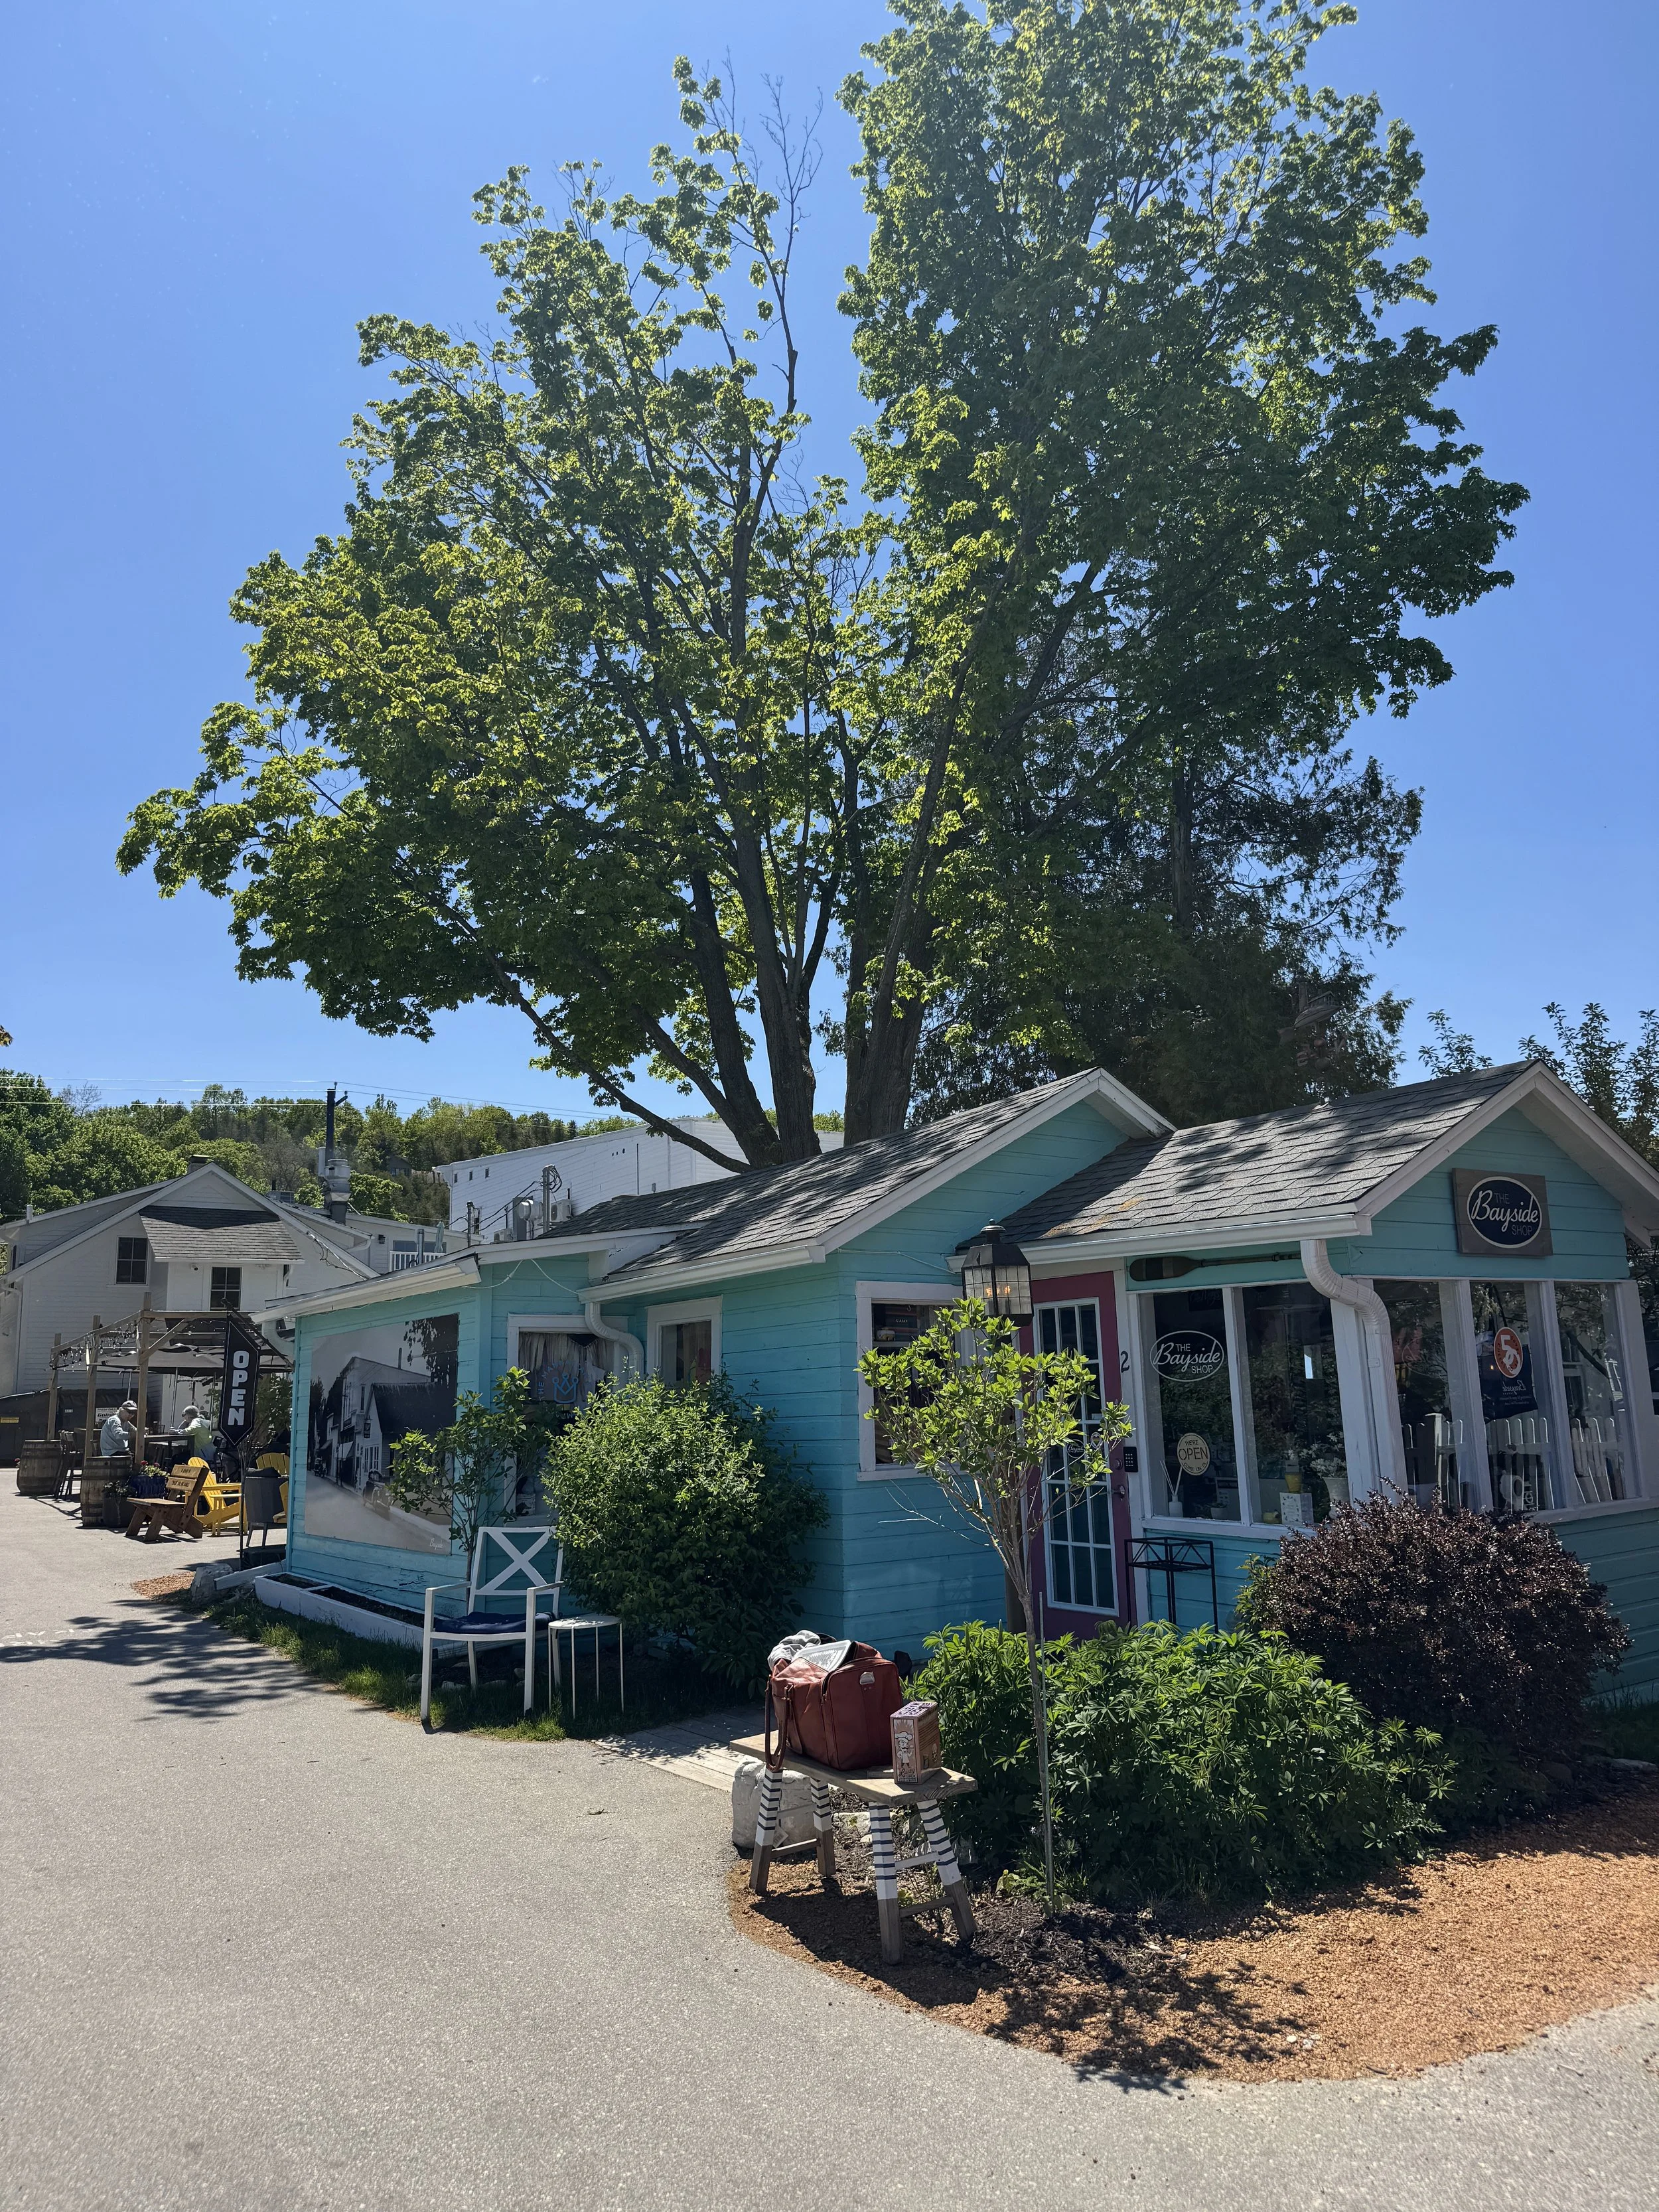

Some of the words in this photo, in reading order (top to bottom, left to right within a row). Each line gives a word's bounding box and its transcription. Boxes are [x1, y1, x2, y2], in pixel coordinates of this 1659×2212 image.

[1494, 1193, 1510, 1204] THE
[1471, 1189, 1539, 1232] Bayside
[1512, 1224, 1533, 1236] SHOP
[1175, 1343, 1190, 1352] THE
[1120, 1351, 1130, 1373] 2
[1153, 1340, 1220, 1372] Bayside
[1191, 1365, 1213, 1374] SHOP
[228, 1351, 250, 1426] OPEN
[1179, 1447, 1208, 1461] OPEN
